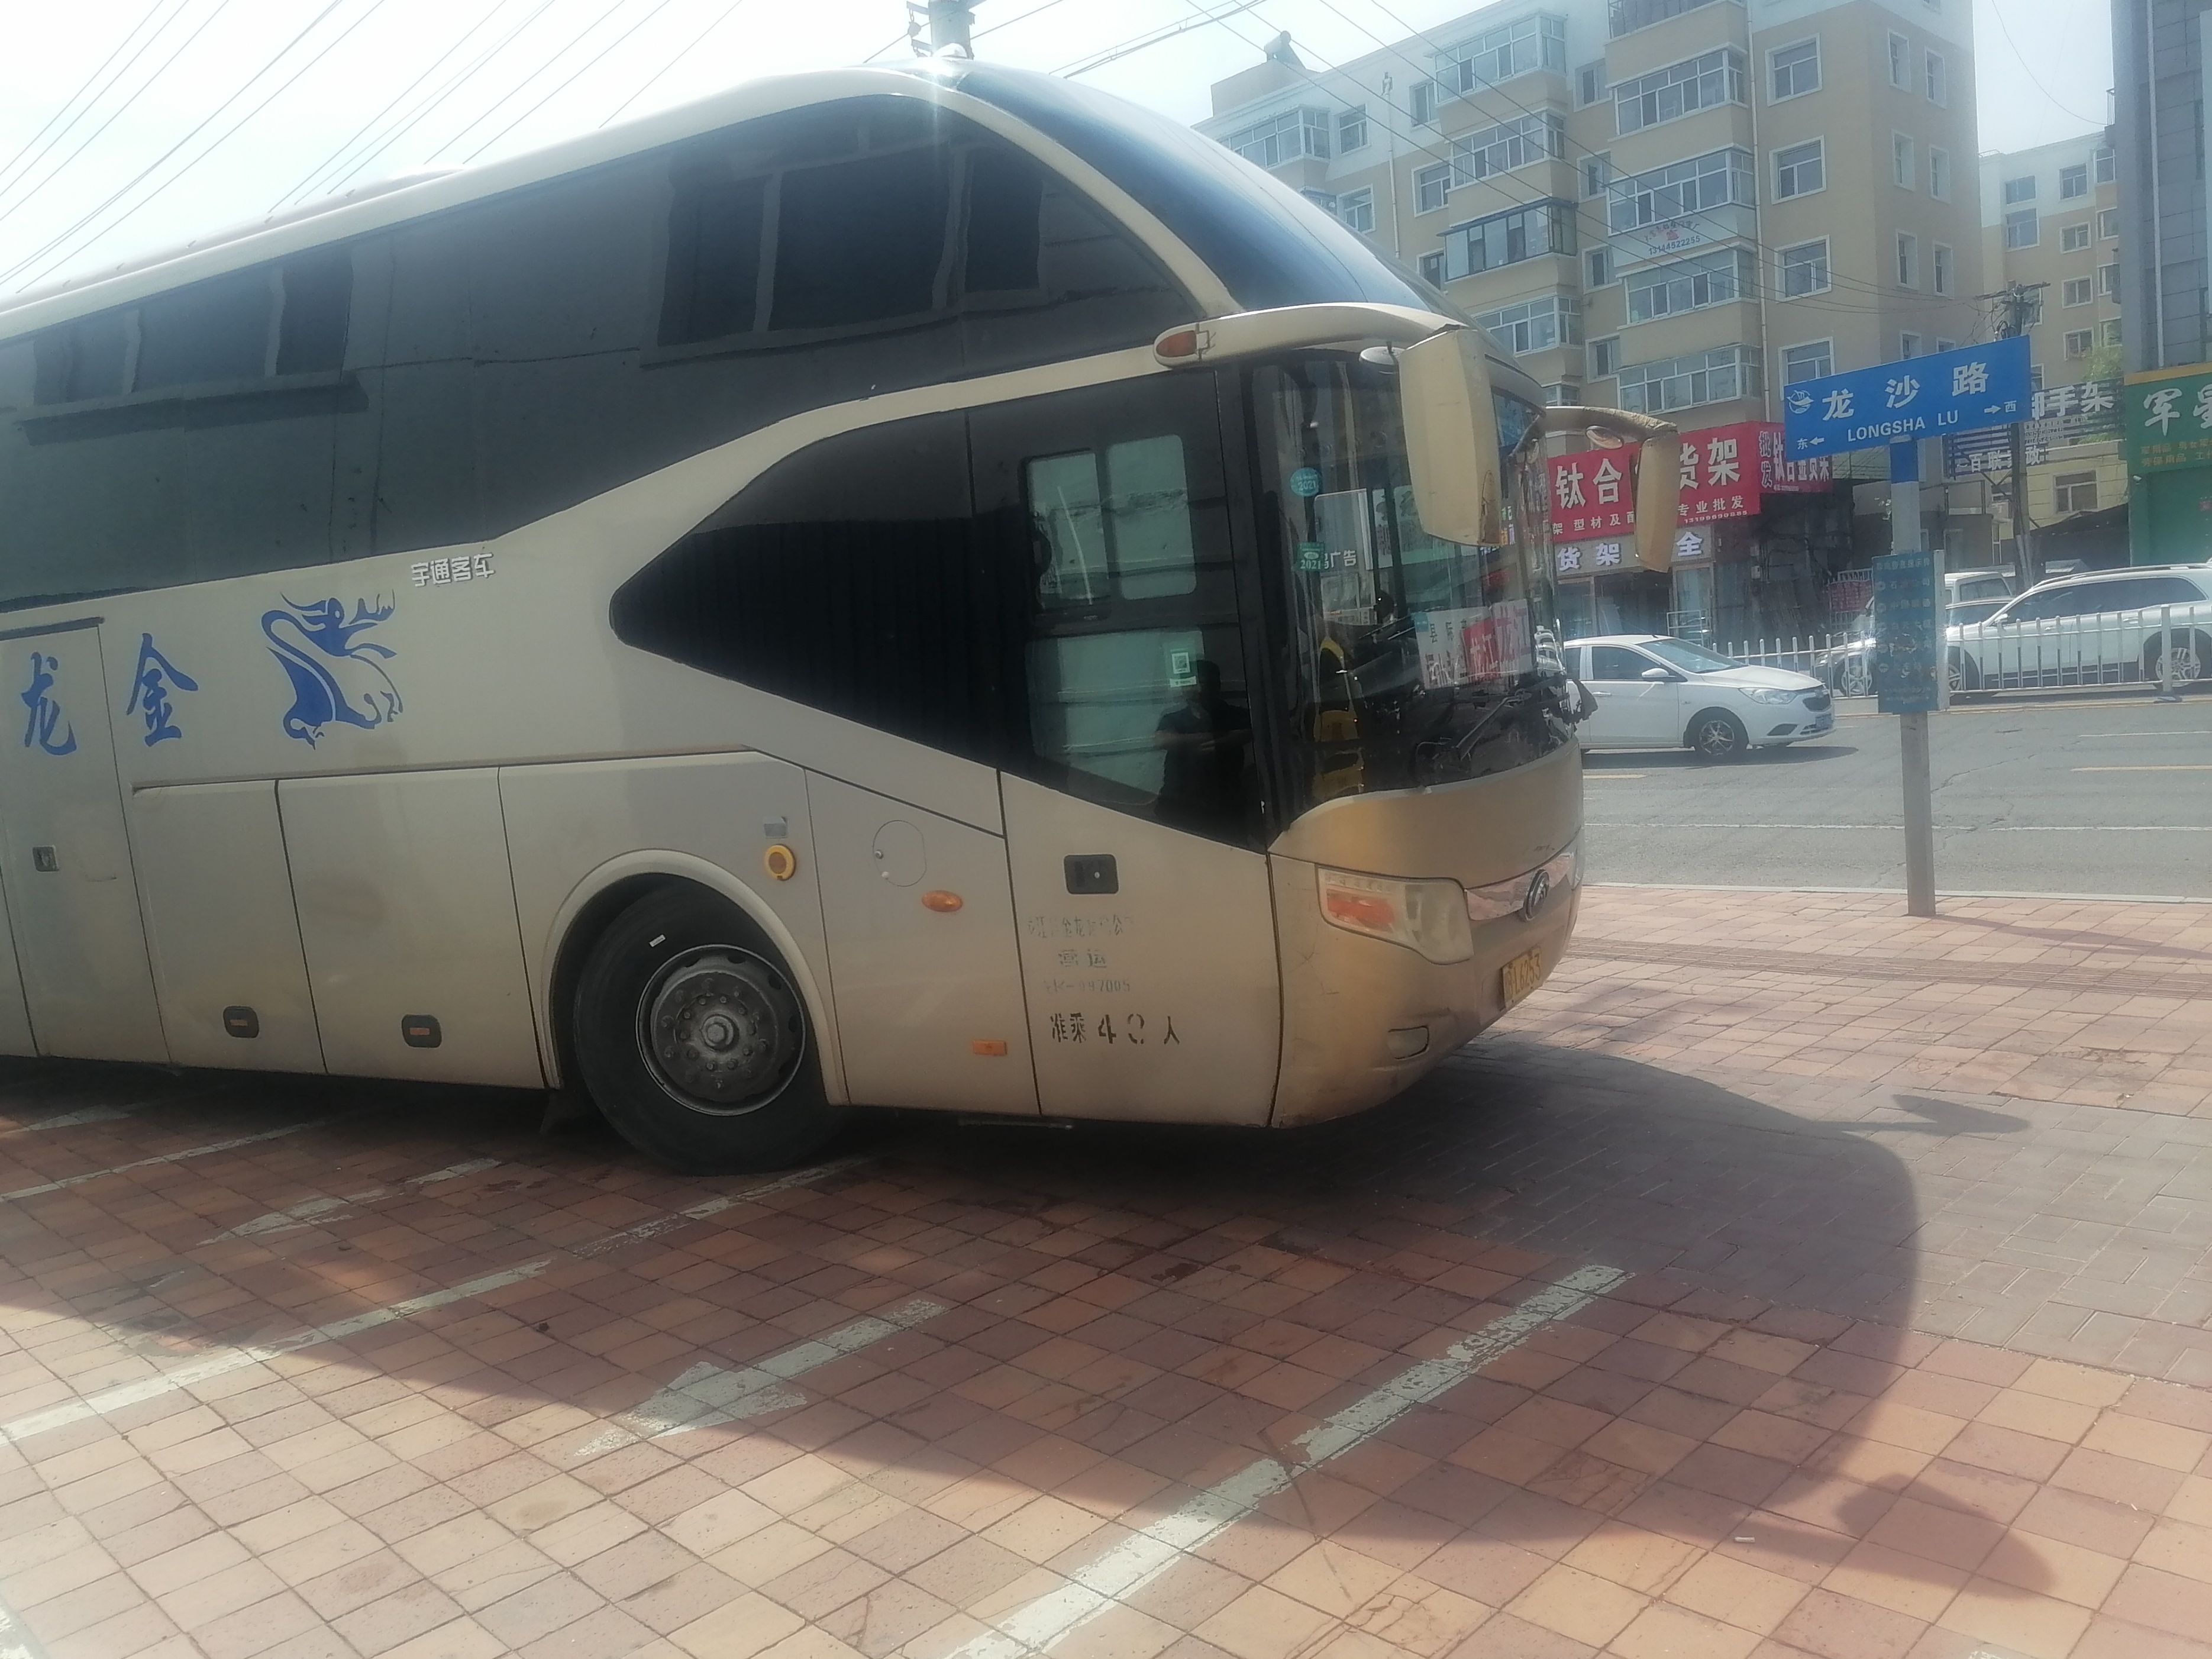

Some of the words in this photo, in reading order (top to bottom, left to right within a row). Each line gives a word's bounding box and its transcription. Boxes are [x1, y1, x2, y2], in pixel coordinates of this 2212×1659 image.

[1648, 235, 1700, 255] 13144522255
[1822, 362, 1989, 421] 龙沙路
[2004, 400, 2017, 413] 西
[1848, 416, 1926, 443] LONGSHA
[1937, 410, 1959, 427] LU
[1797, 438, 1809, 450] 东
[1555, 438, 1740, 509] 钛合货架
[1298, 480, 1316, 491] 2021
[1677, 495, 1744, 517] 专业批发
[1557, 531, 1703, 572] 货架全
[411, 553, 495, 587] 宇通客车
[1300, 559, 1321, 569] 2021
